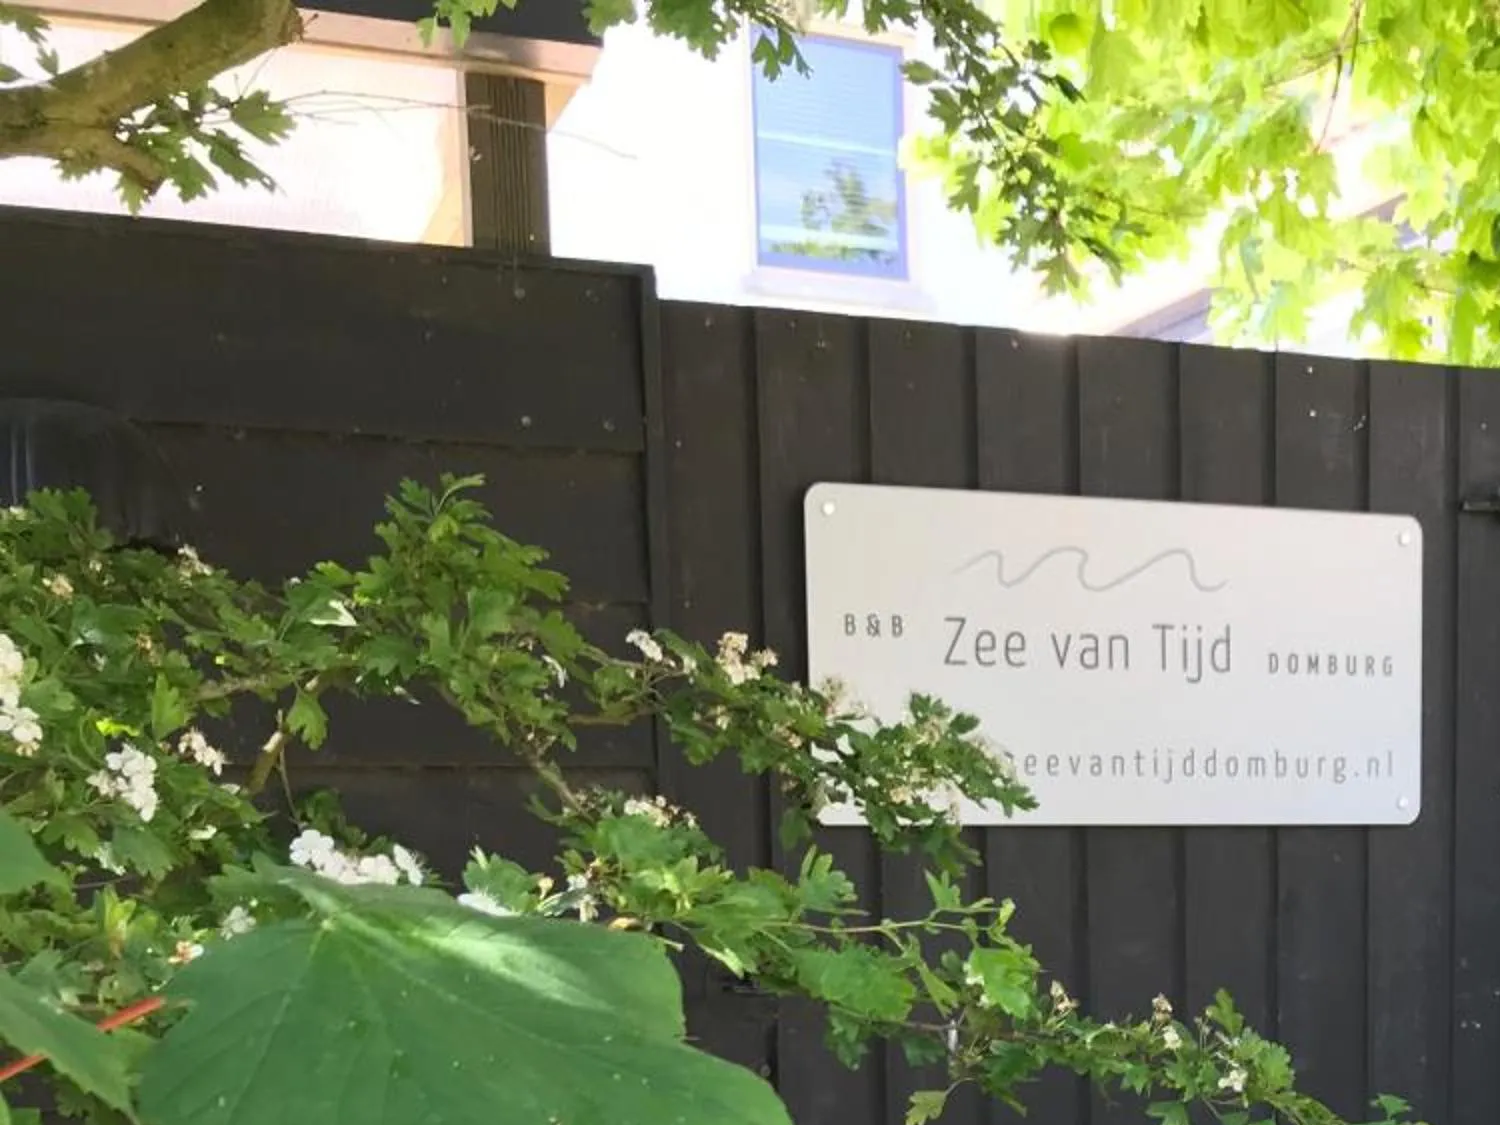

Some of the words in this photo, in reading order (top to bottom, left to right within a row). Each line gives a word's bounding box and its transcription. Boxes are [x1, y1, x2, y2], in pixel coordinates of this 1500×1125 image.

[943, 615, 1028, 669] Zee
[1050, 632, 1130, 671] van
[1151, 623, 1232, 685] Tijd
[1267, 652, 1394, 677] DOMBURG
[1003, 748, 1395, 786] eevantijddomburg.nl
